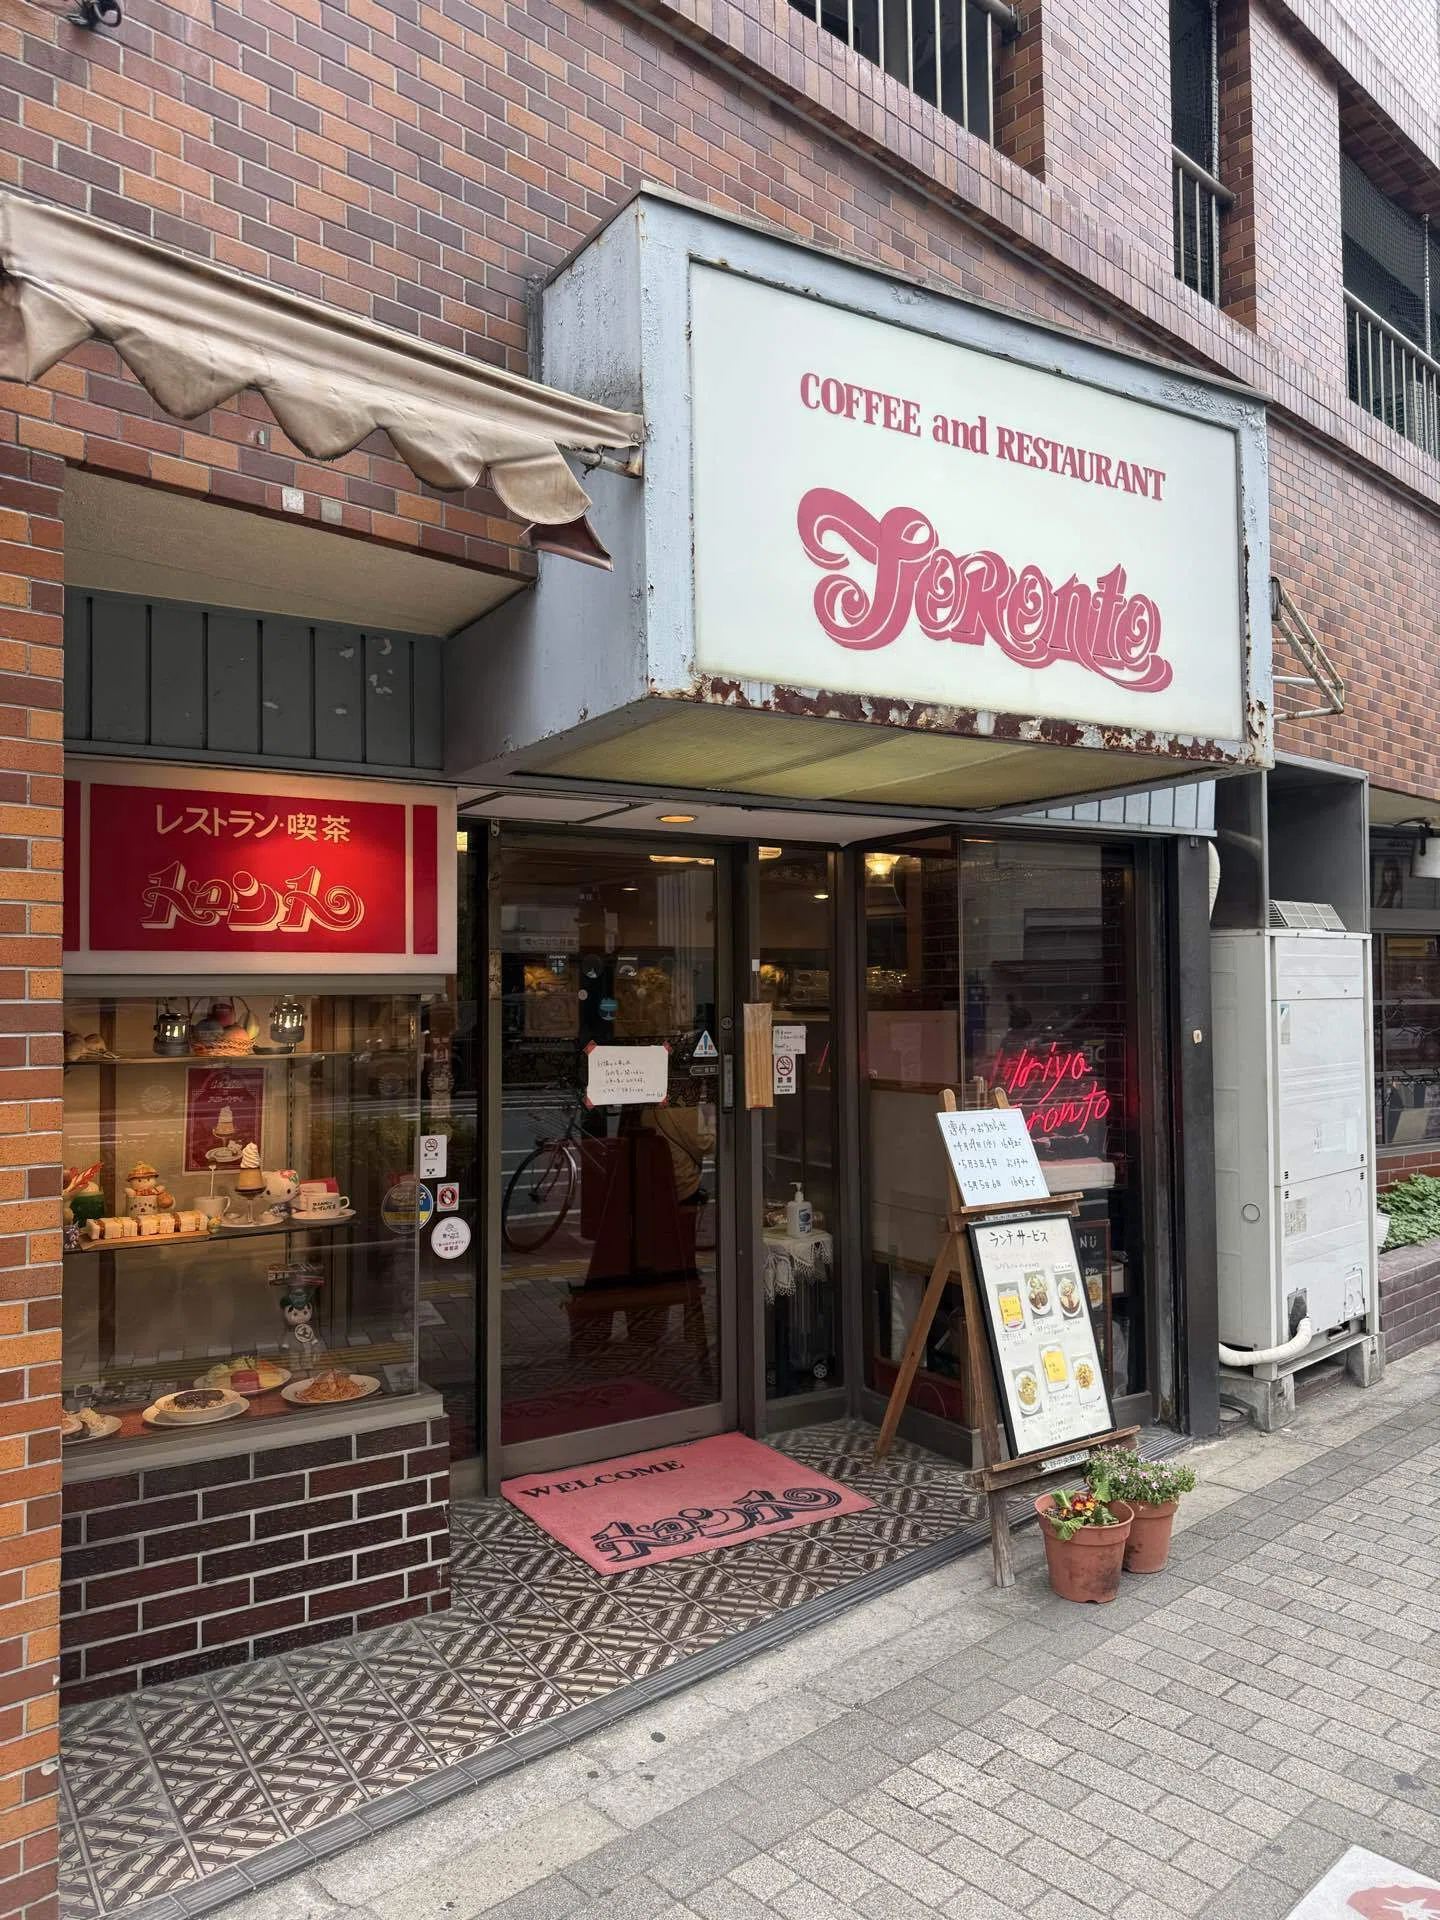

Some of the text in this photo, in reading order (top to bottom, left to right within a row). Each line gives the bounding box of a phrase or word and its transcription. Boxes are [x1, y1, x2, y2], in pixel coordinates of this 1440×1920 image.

[800, 372, 1167, 501] COFFEE and RESTAURANT
[156, 804, 351, 843] レストラン・喫茶
[141, 860, 365, 933] トロント
[520, 1460, 685, 1499] WELCOME
